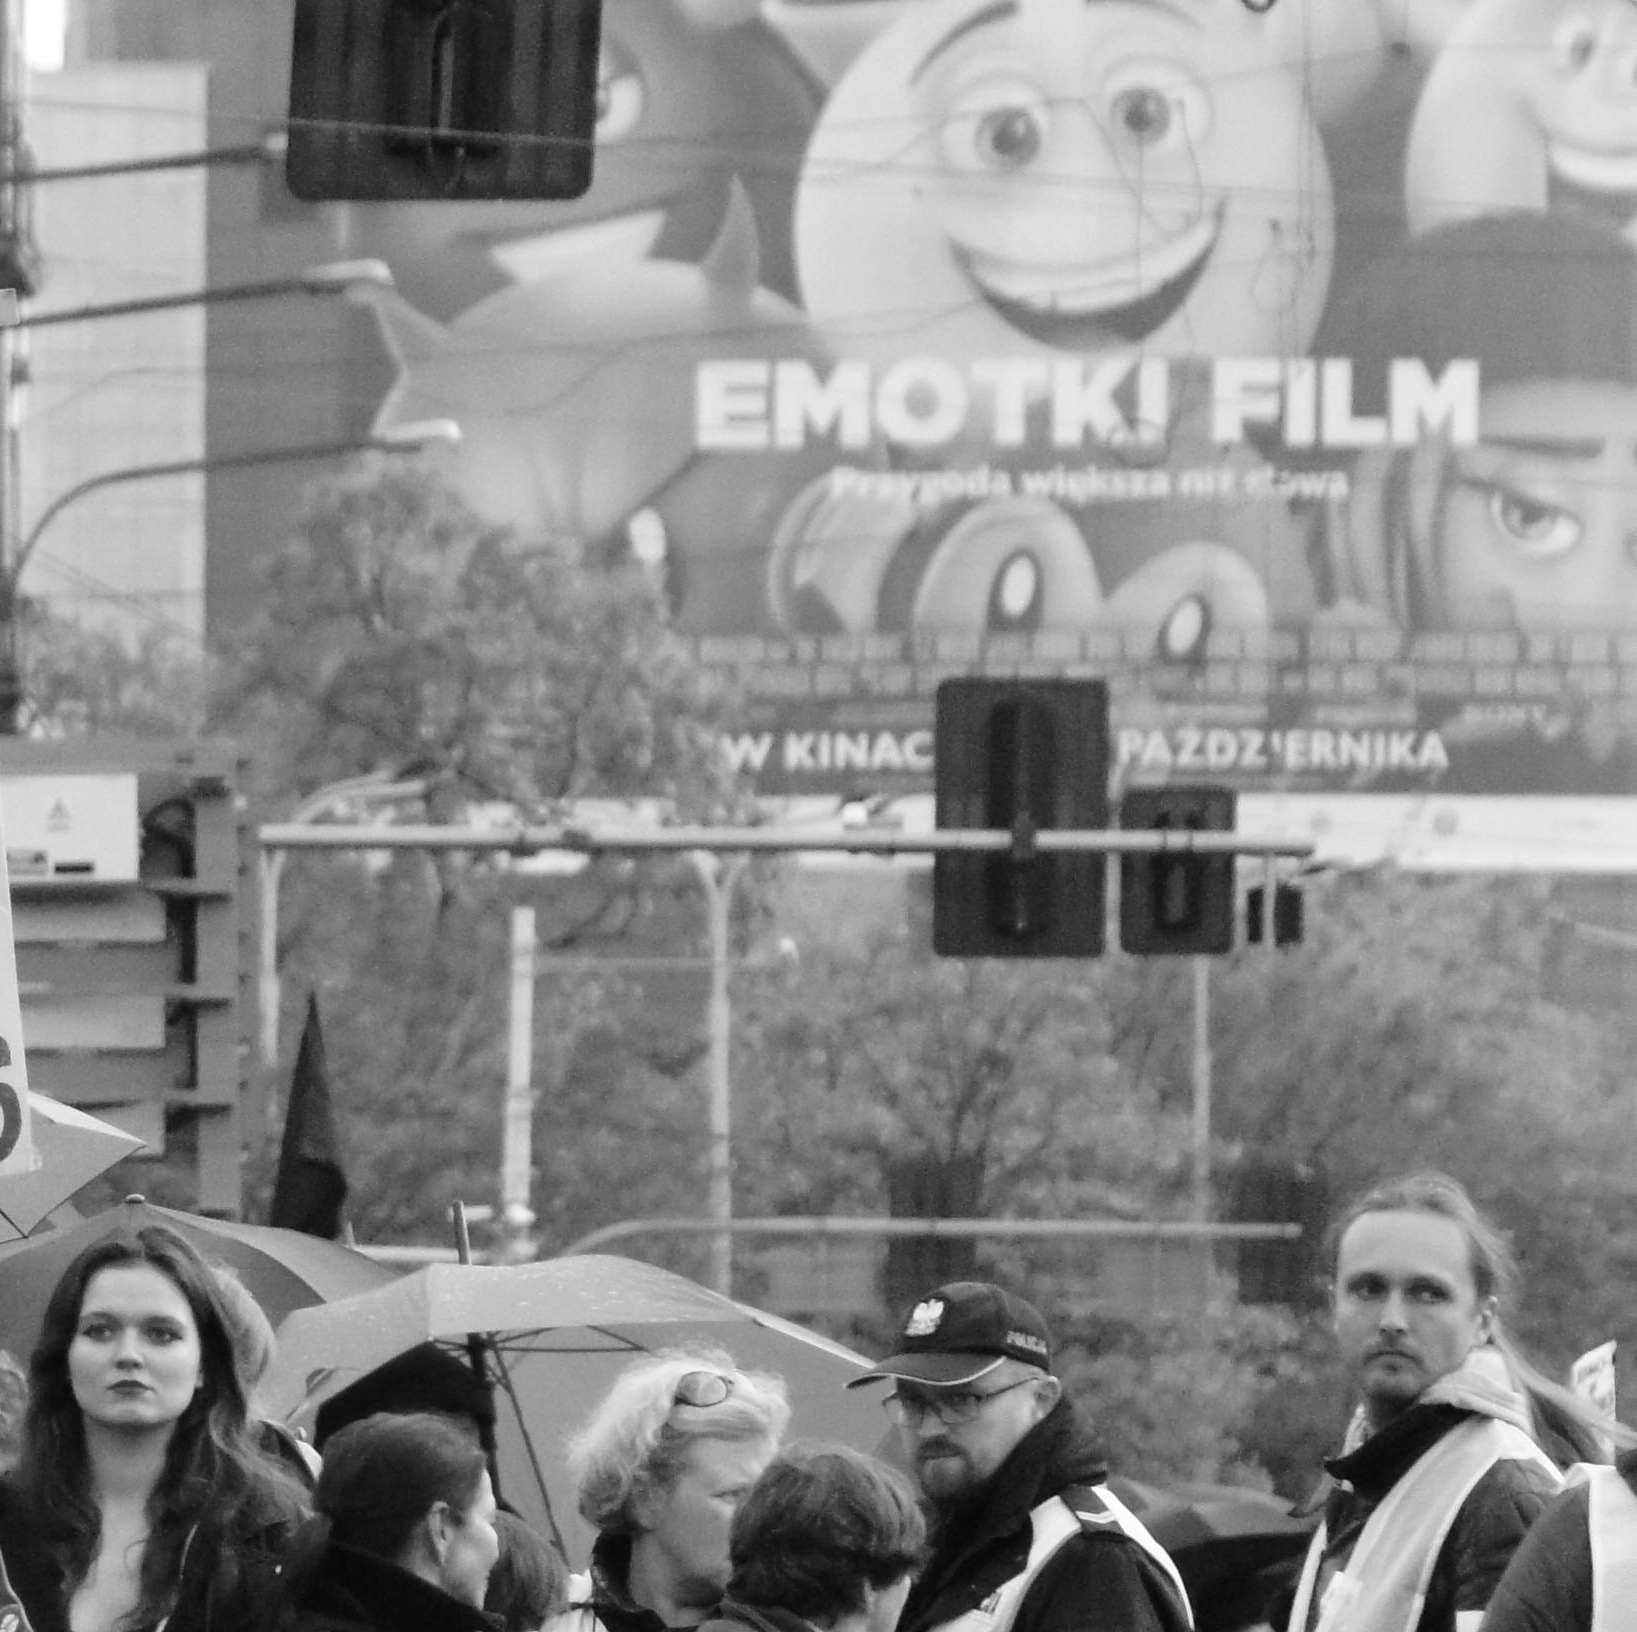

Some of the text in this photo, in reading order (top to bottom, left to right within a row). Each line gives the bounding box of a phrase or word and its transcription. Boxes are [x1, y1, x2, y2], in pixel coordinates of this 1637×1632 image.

[696, 355, 1480, 449] EMOTKI FILM
[719, 729, 773, 772] W
[783, 729, 937, 772] KINAC
